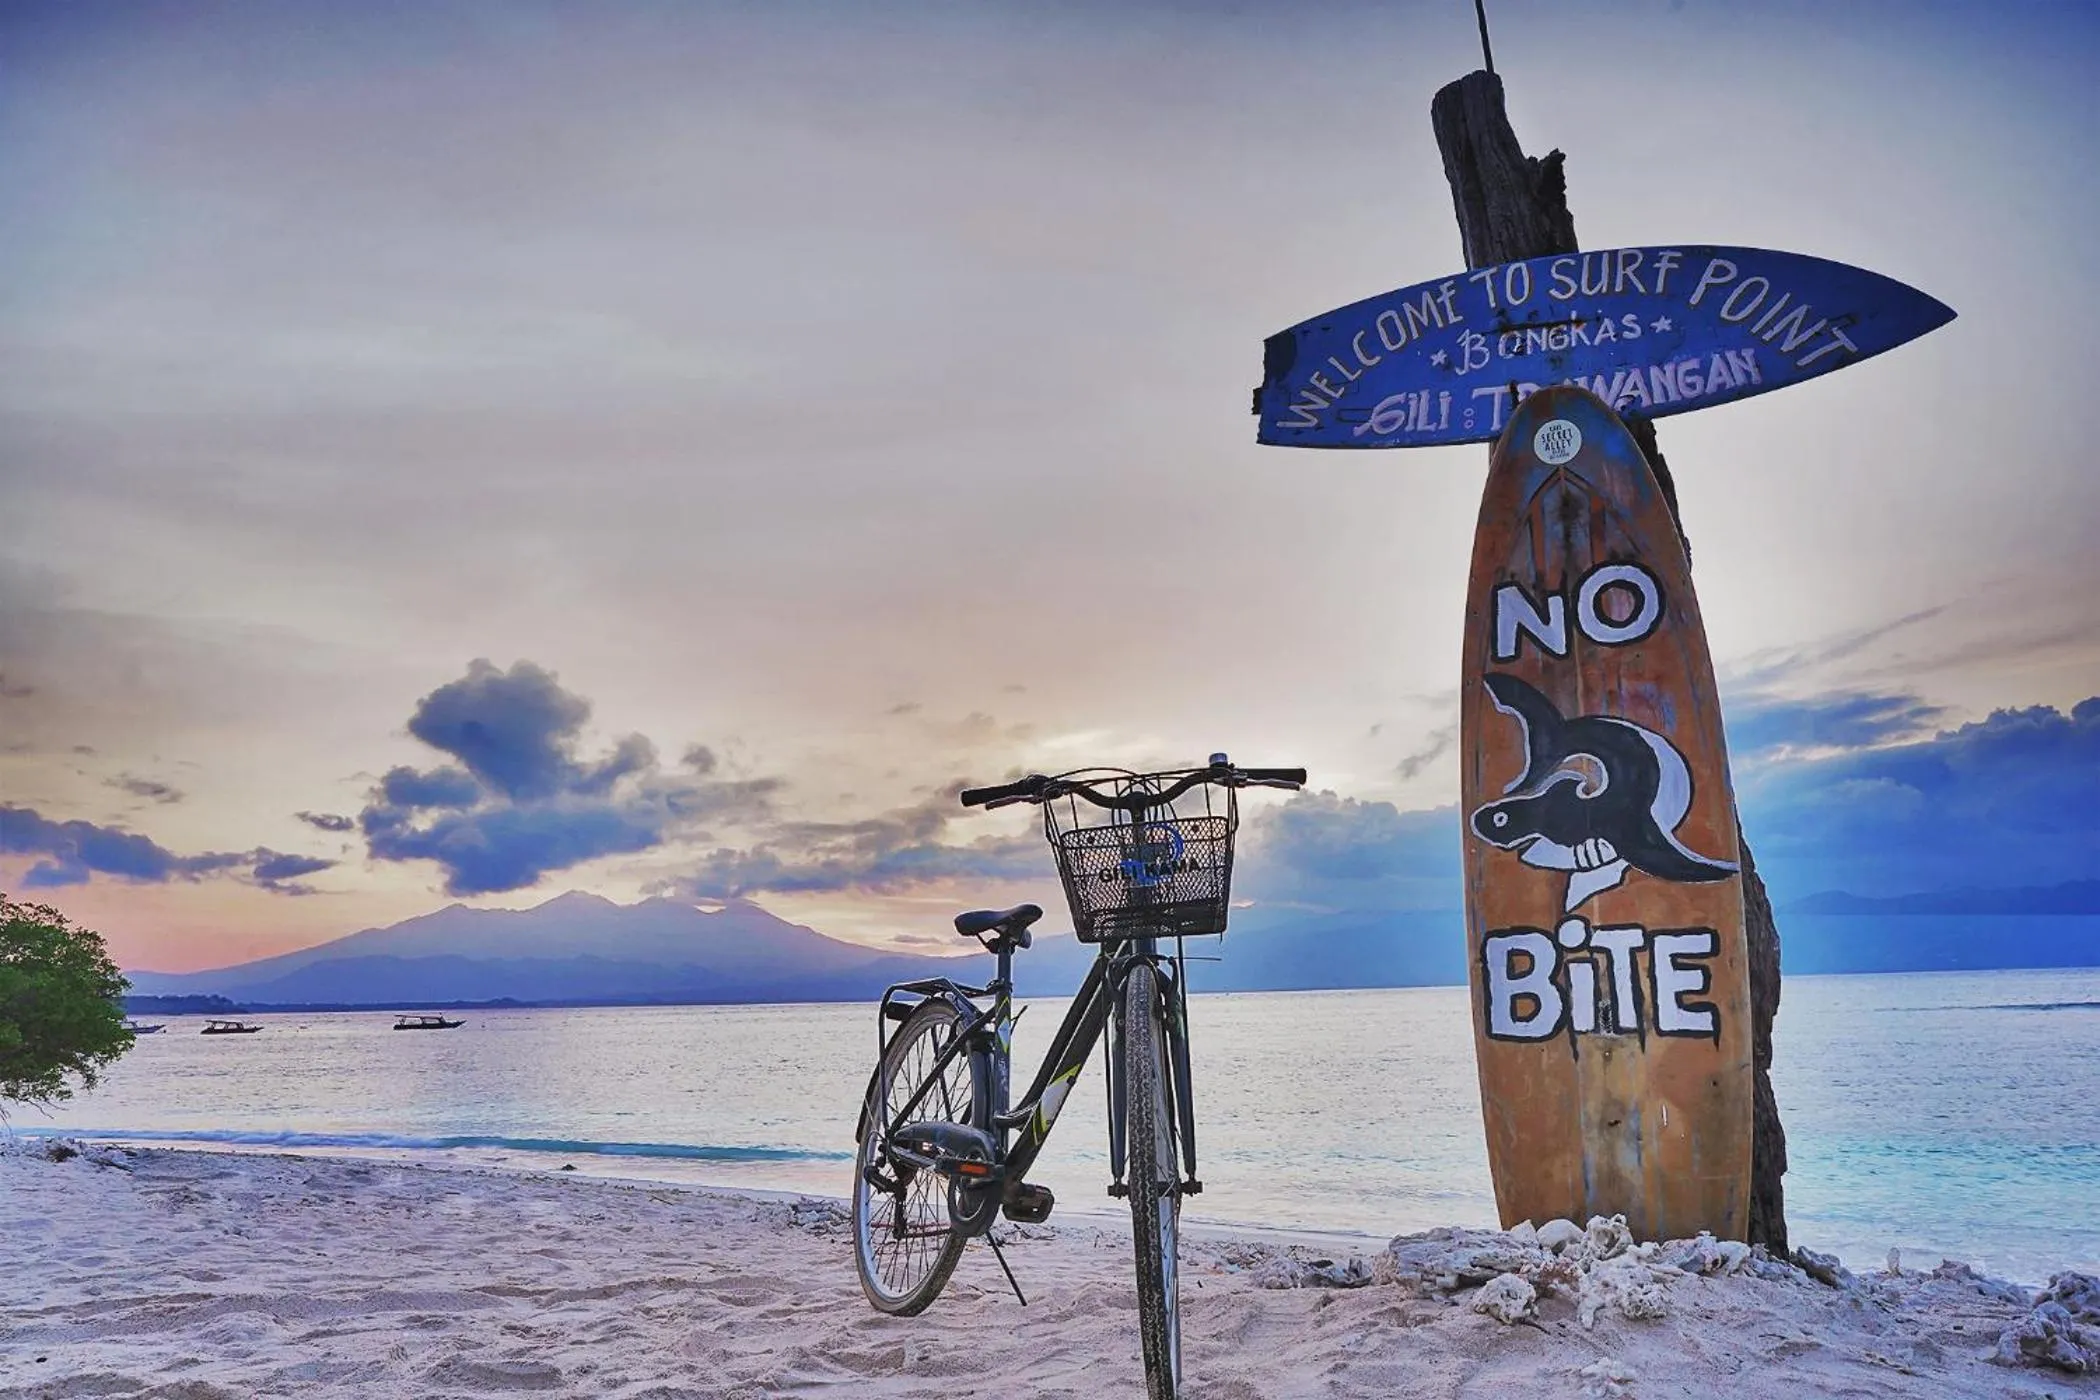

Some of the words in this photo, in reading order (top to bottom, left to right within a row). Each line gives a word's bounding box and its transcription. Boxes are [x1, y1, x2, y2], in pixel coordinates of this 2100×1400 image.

[1276, 279, 1464, 429] WELCOME
[1469, 261, 1531, 309] TO
[1547, 247, 1683, 300] SURF
[1688, 258, 1859, 366] POINT
[1454, 310, 1643, 376] BONGKAS
[1492, 560, 1666, 662] NO
